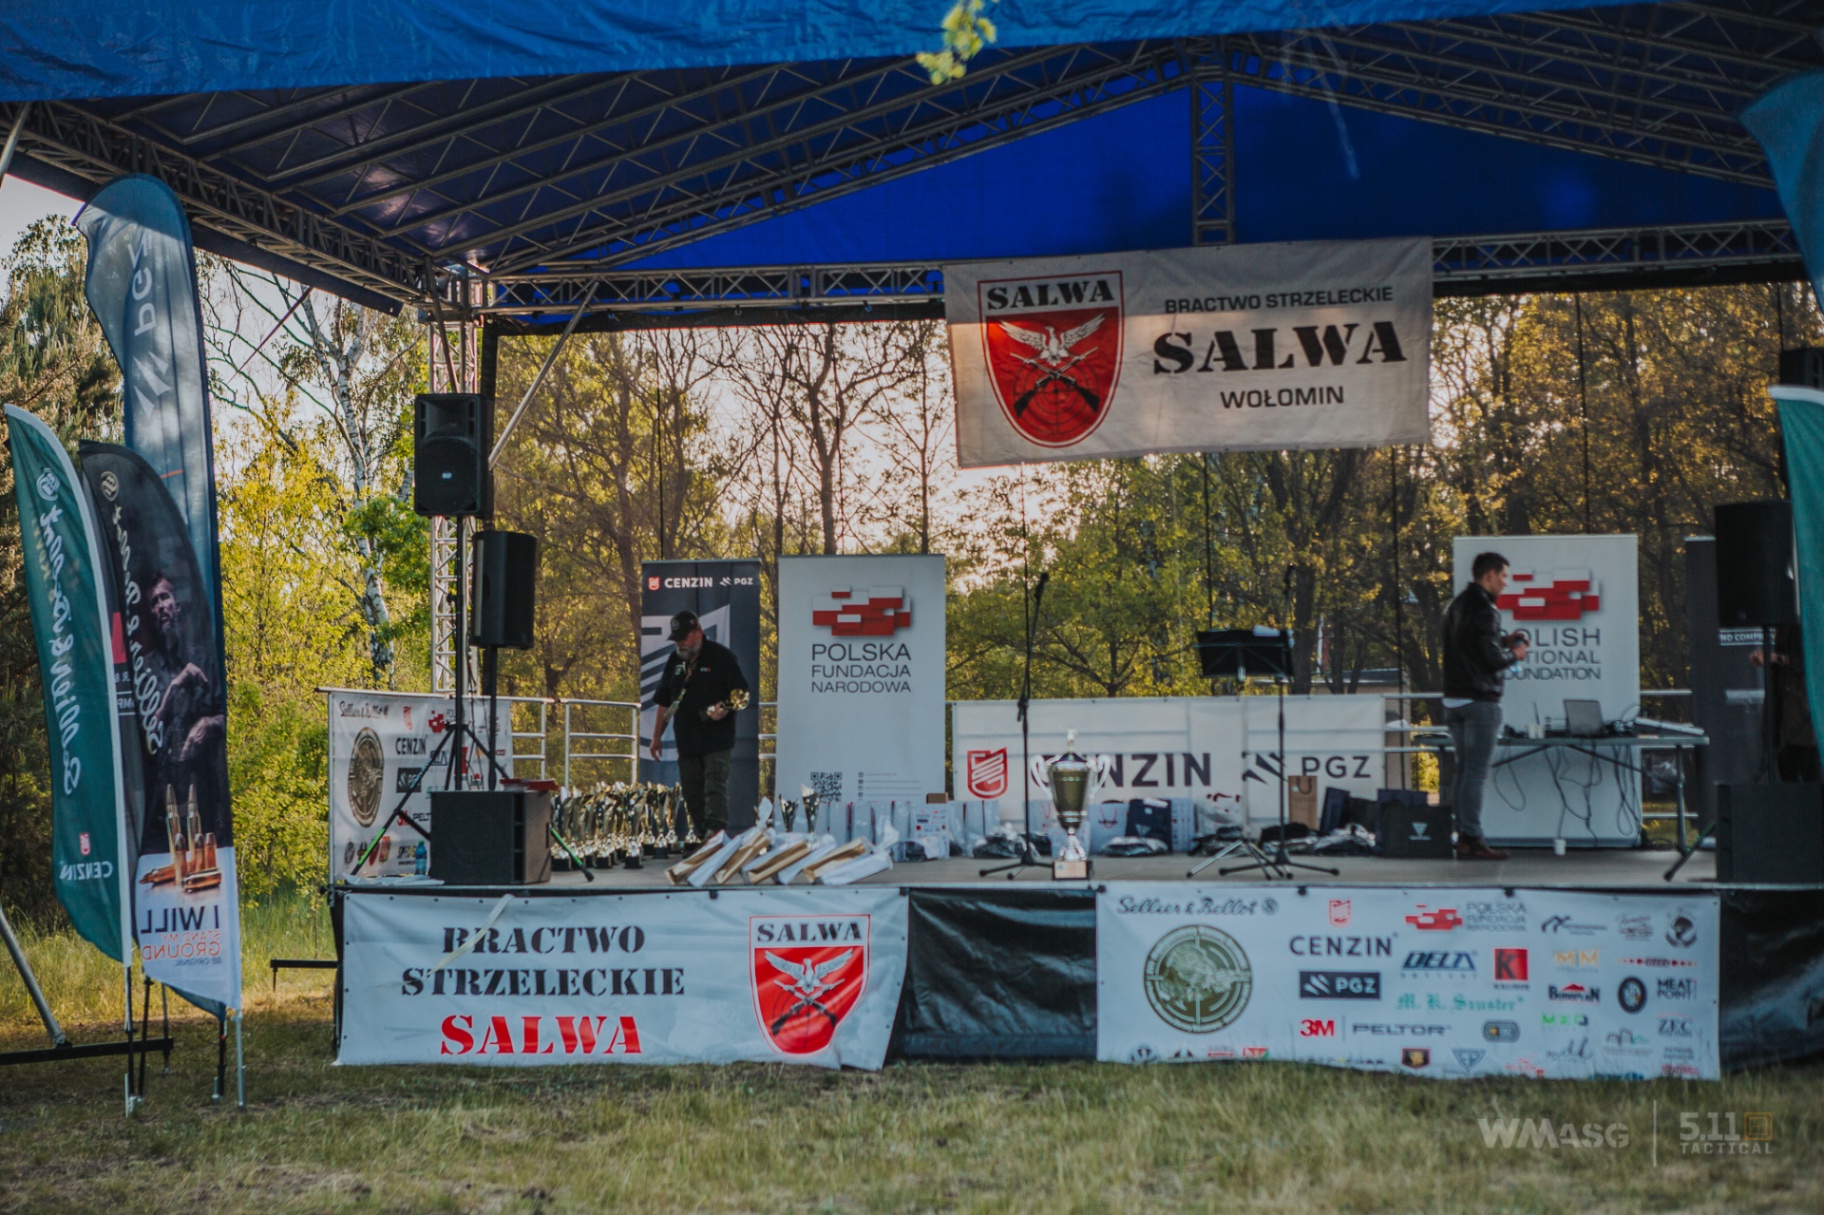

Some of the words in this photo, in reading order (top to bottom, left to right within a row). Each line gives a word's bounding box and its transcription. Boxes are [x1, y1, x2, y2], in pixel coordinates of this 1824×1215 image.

[986, 279, 1115, 311] SALWA
[1165, 294, 1262, 315] BRACTWO
[1266, 286, 1394, 309] STRZELECKIE
[1153, 320, 1407, 375] SALWA
[1220, 385, 1344, 409] WOŁOMIN
[664, 577, 713, 589] CENZIN
[734, 577, 753, 586] PGZ
[1720, 633, 1733, 642] NO
[1734, 632, 1764, 642] COMPR
[811, 643, 912, 662] POLSKA
[1525, 650, 1601, 665] TIONAL
[811, 665, 911, 678] FUNDACJA
[1501, 667, 1601, 680] OUNDATION
[811, 681, 911, 693] NARODOWA
[395, 737, 426, 755] CENZIN
[1302, 755, 1372, 780] PGZ
[442, 925, 645, 954] BRACTWO
[757, 921, 862, 943] SALWA
[1290, 936, 1391, 957] CENZIN
[1403, 952, 1476, 971] DELTA
[402, 967, 685, 997] STRZELECKIE
[1335, 977, 1377, 994] PGZ
[1658, 978, 1692, 989] MEAT
[441, 1014, 643, 1056] SALWA
[1300, 1019, 1335, 1037] 3M
[1353, 1024, 1446, 1036] PELTOR
